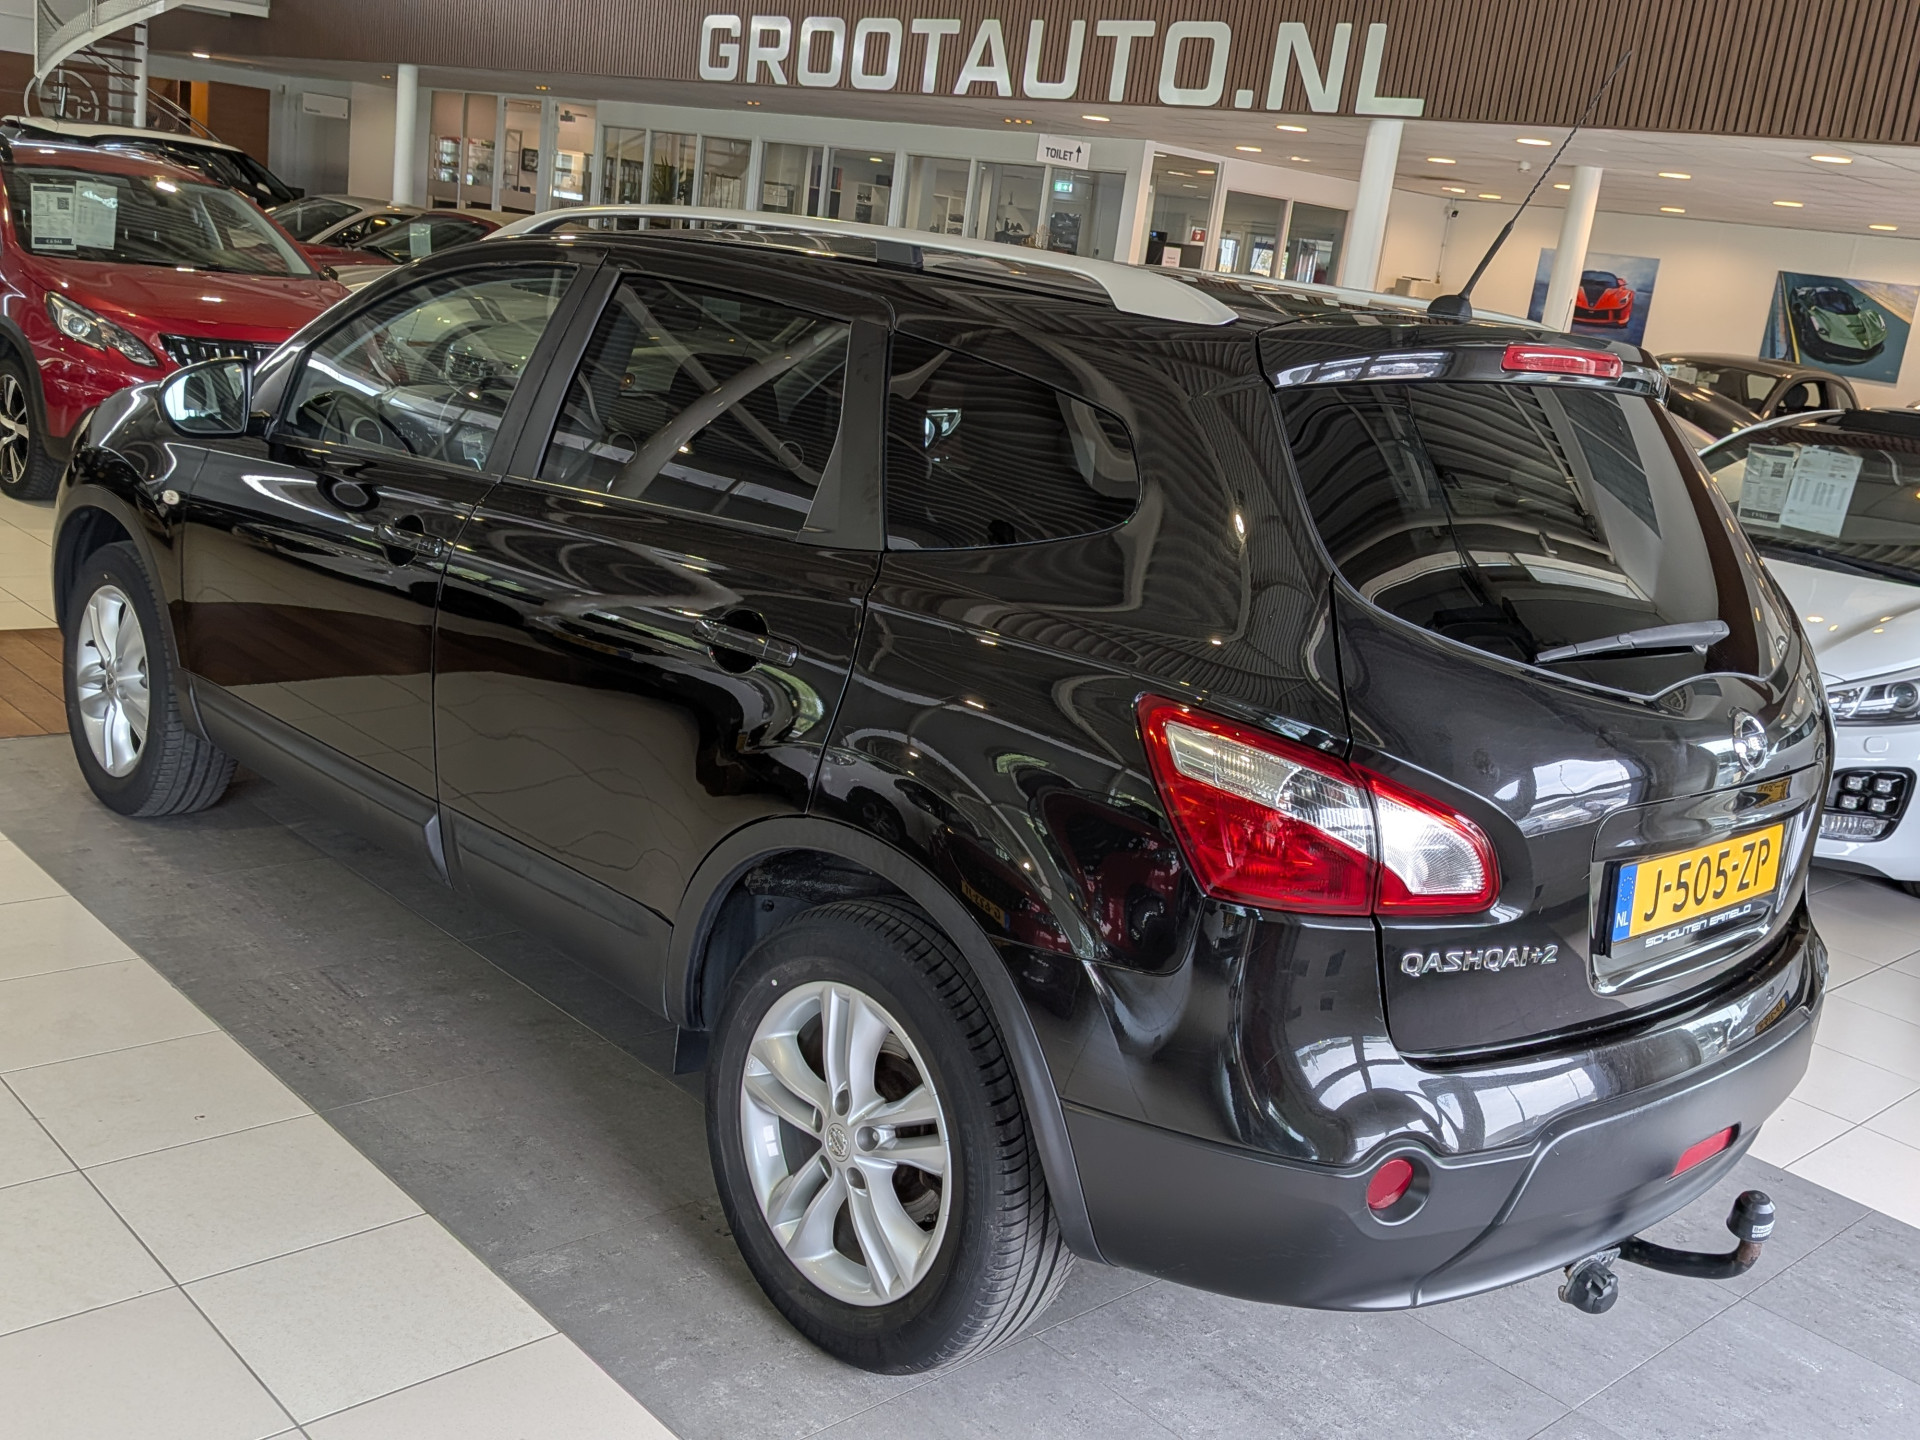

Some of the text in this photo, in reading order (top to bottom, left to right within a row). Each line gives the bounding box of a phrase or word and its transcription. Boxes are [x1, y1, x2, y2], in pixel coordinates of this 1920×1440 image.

[699, 14, 1425, 117] GROOTAUTO.NL
[1046, 146, 1074, 162] TOILET
[1643, 837, 1772, 922] J-505-ZP
[1615, 909, 1630, 929] NL
[1644, 903, 1753, 948] SCHOUTEN ERMELO
[1400, 943, 1560, 978] QASHQAI+2
